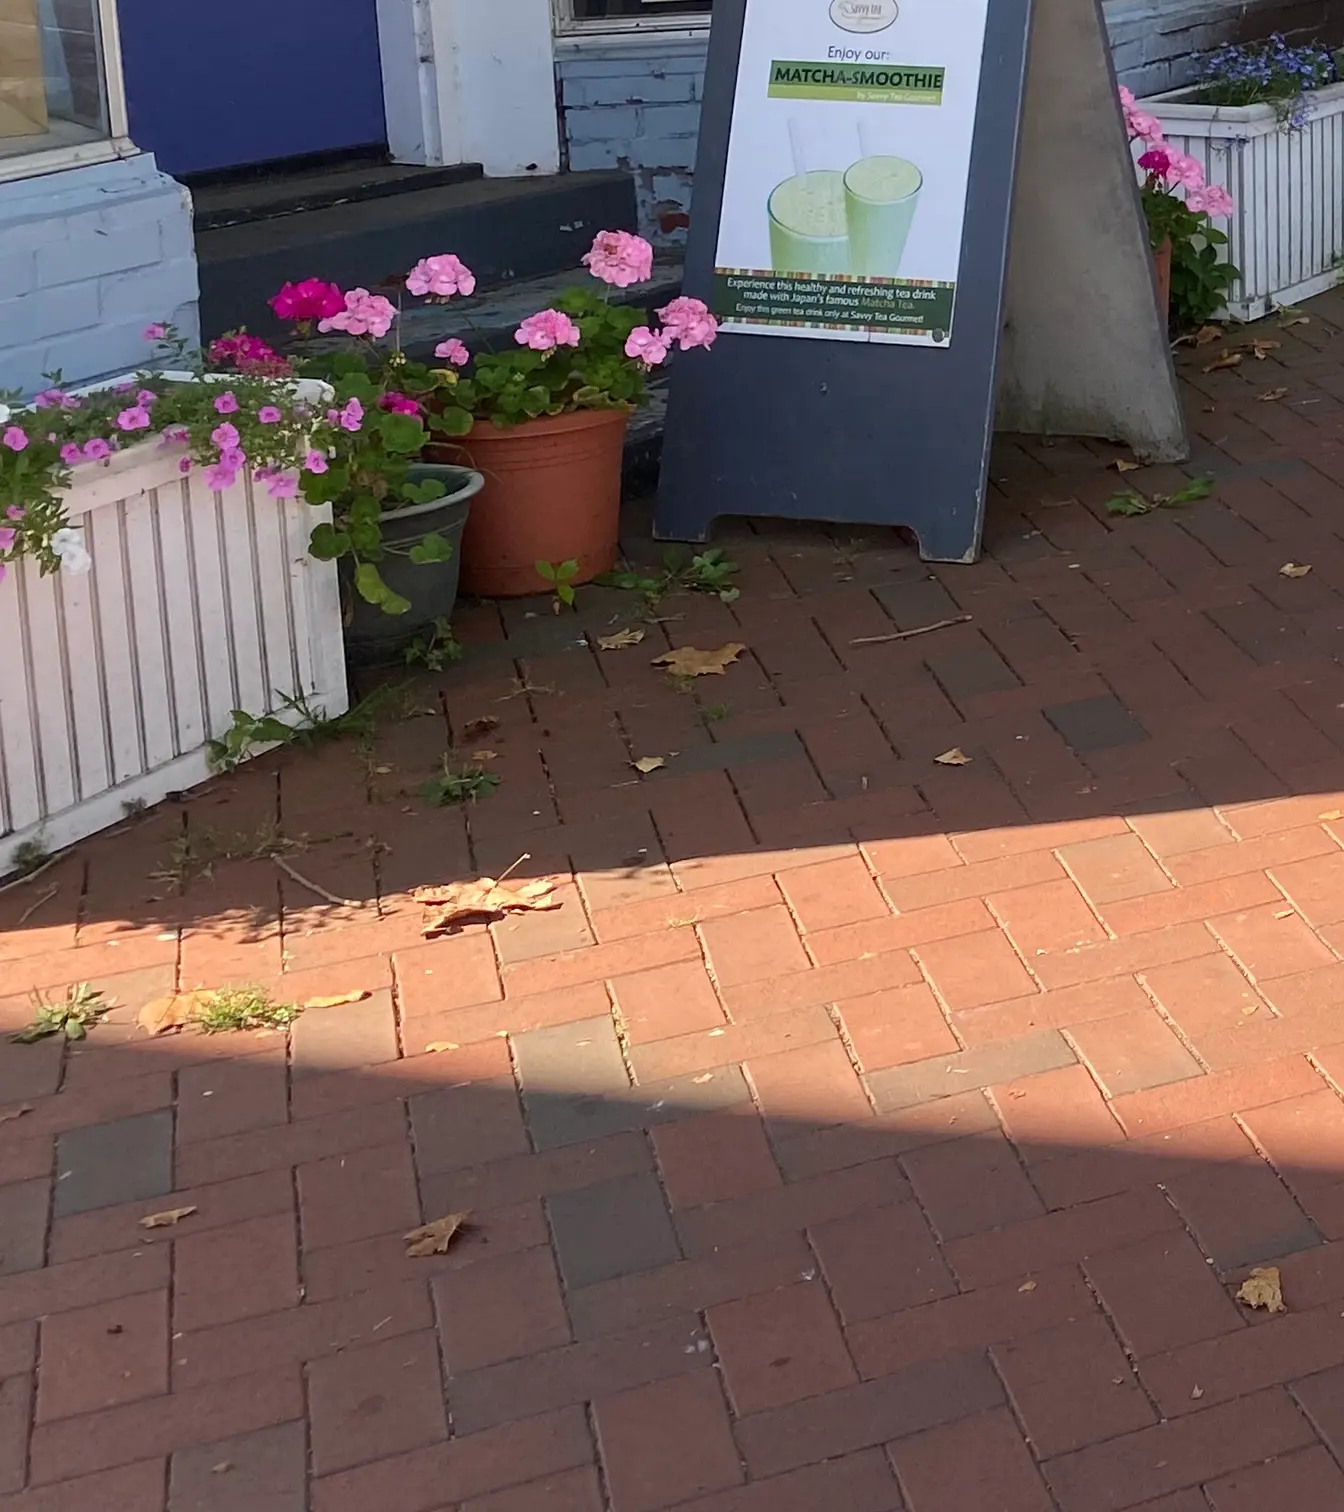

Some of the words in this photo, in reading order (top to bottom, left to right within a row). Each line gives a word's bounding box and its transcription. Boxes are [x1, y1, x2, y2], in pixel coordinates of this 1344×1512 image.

[827, 46, 861, 62] Enjoy
[865, 50, 890, 60] our:
[775, 67, 942, 88] MATCHA-SMOOTHIE
[727, 278, 775, 290] Experience
[777, 280, 792, 291] this
[794, 282, 827, 295] healthy
[829, 284, 846, 294] and
[847, 285, 894, 300] refreshing
[895, 289, 910, 299] tea
[912, 289, 936, 300] drink
[744, 290, 767, 300] made
[770, 292, 789, 301] with
[791, 293, 824, 304] Japan's
[826, 294, 859, 306] famous
[861, 297, 895, 308] Matcha
[736, 303, 756, 314] Enjoy
[771, 306, 791, 315] green
[793, 307, 804, 315] tea
[824, 309, 840, 319] only
[850, 310, 873, 321] Savvy
[874, 312, 887, 321] Tea
